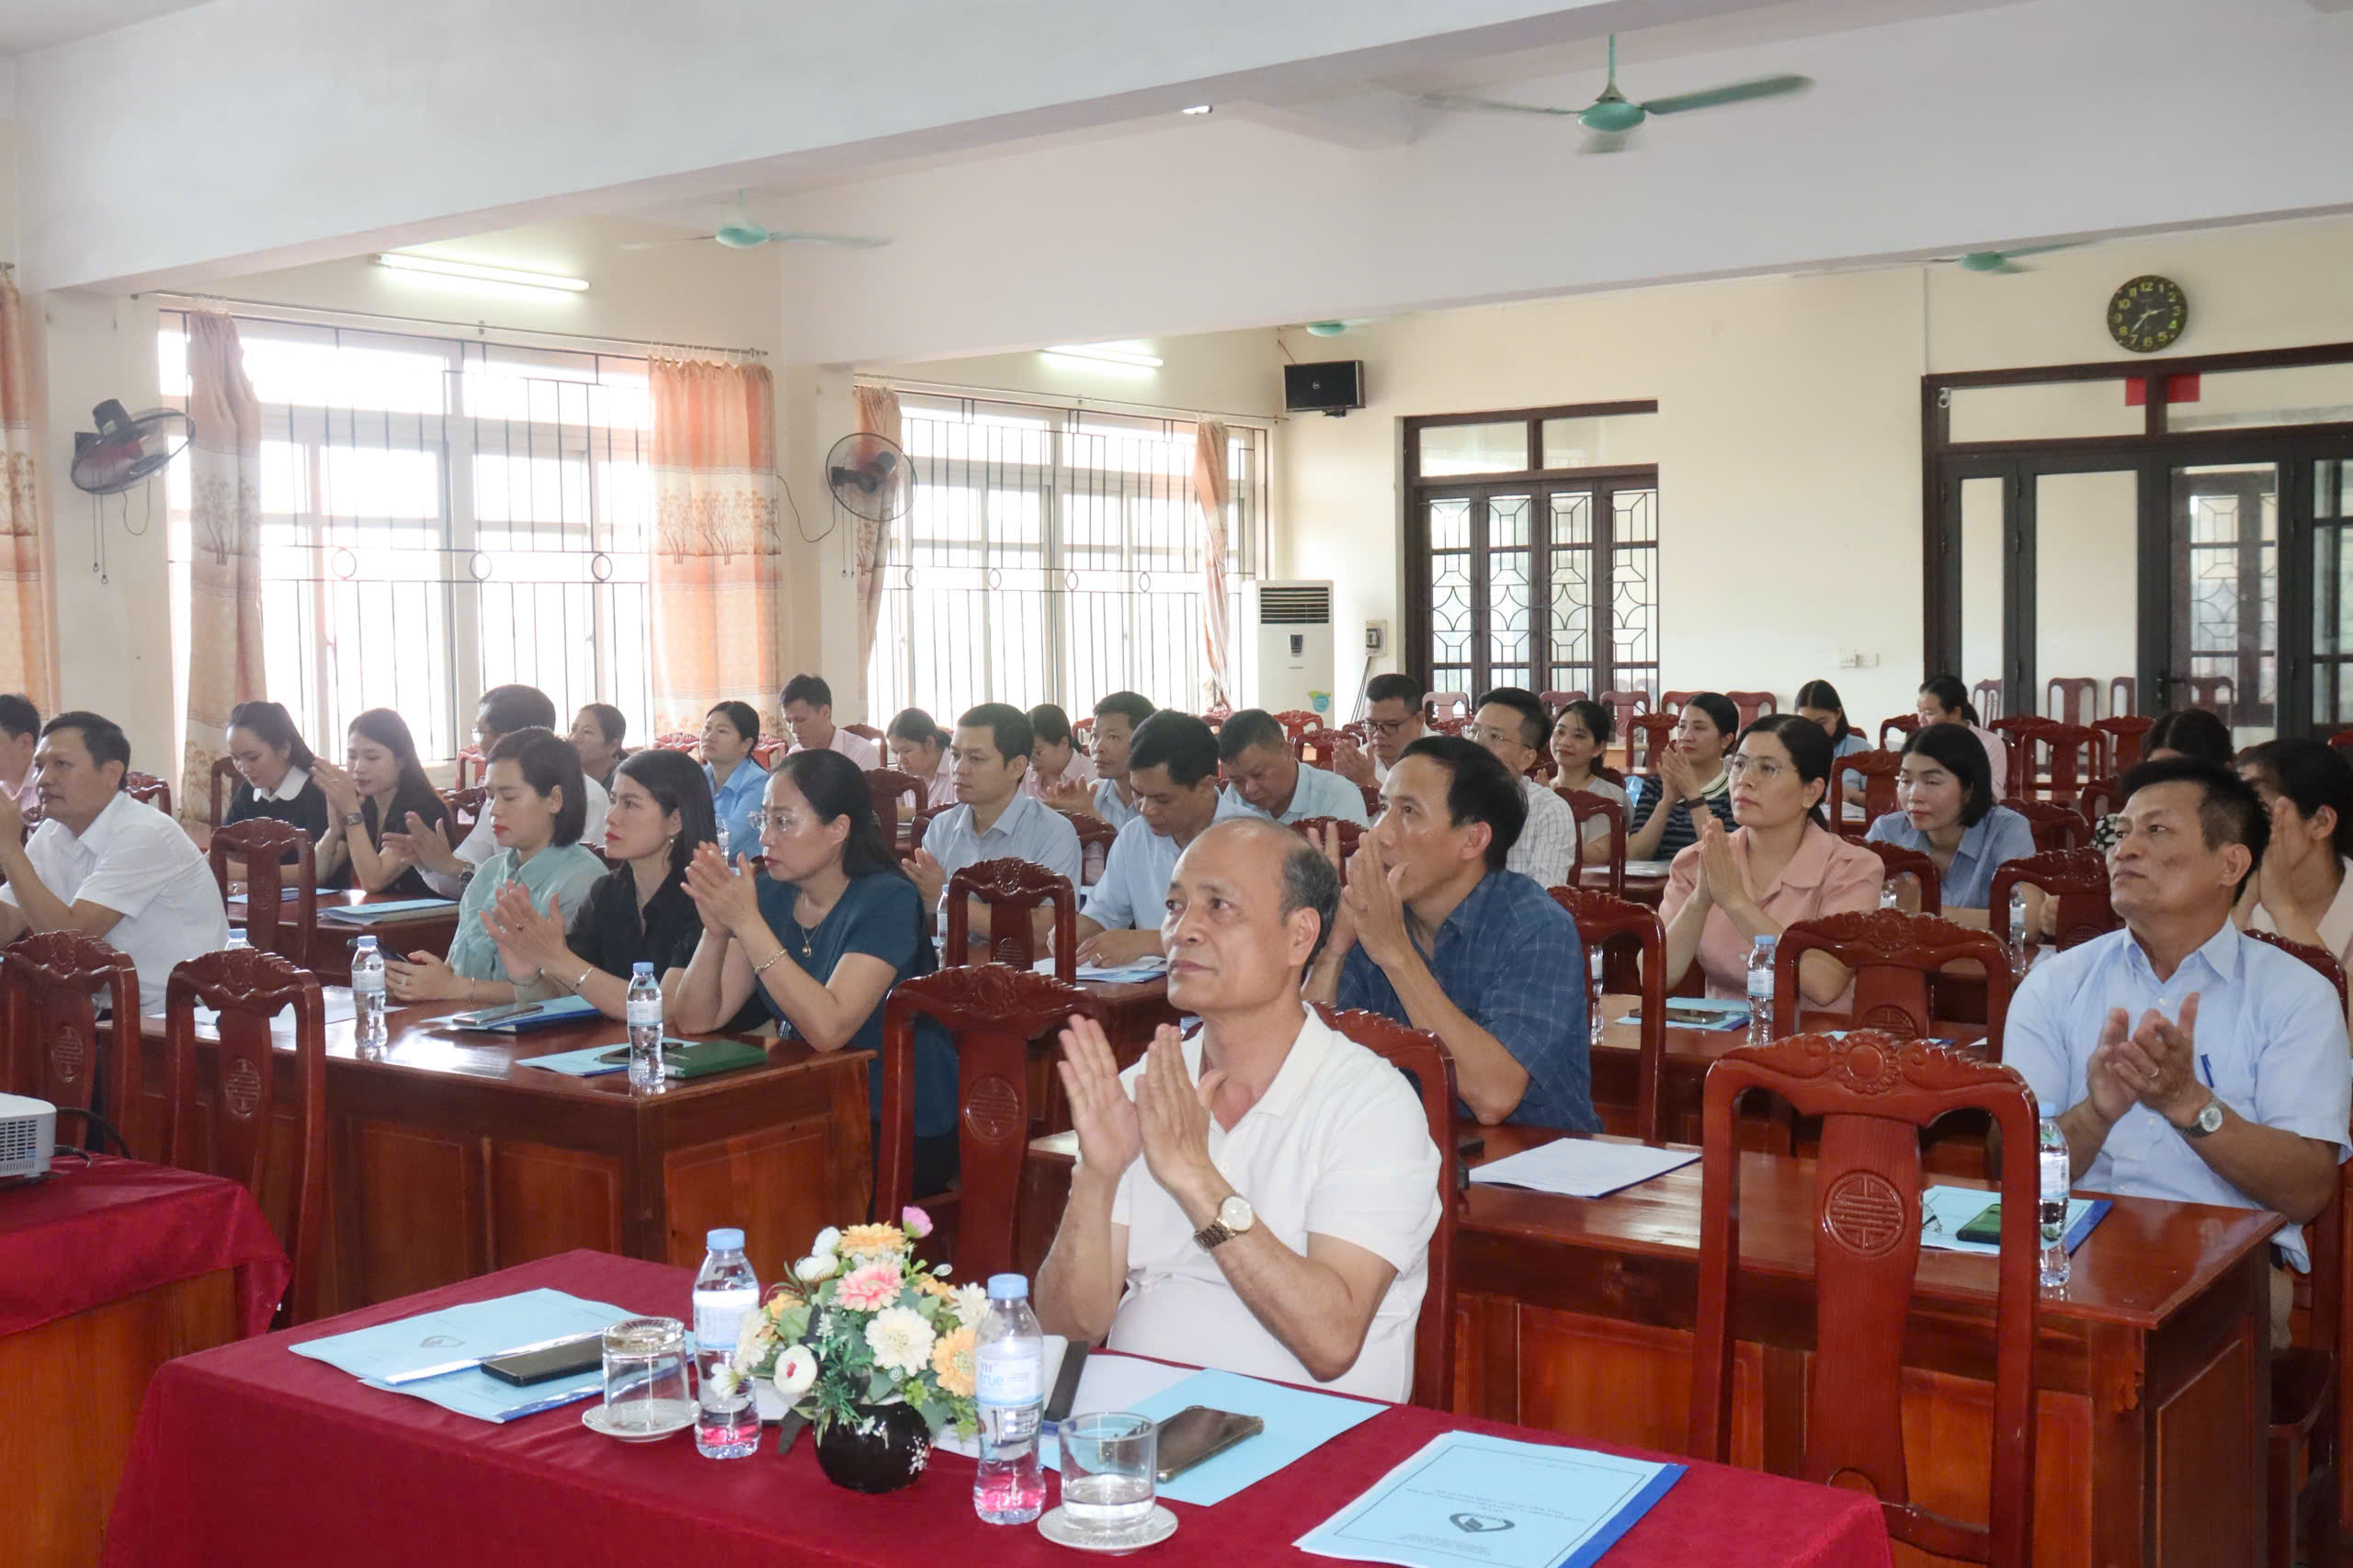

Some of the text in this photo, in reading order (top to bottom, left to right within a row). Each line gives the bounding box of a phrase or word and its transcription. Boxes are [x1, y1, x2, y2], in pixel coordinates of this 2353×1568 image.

[2140, 281, 2154, 292] 12
[2159, 283, 2164, 293] 1
[2168, 292, 2177, 302] 2
[2118, 299, 2131, 310] 10
[2172, 305, 2181, 316] 3
[2115, 312, 2123, 324] 9
[2168, 319, 2177, 329] 4
[2119, 326, 2129, 336] 8
[2158, 331, 2167, 342] 5
[2131, 334, 2140, 345] 7
[2143, 335, 2153, 347] 6
